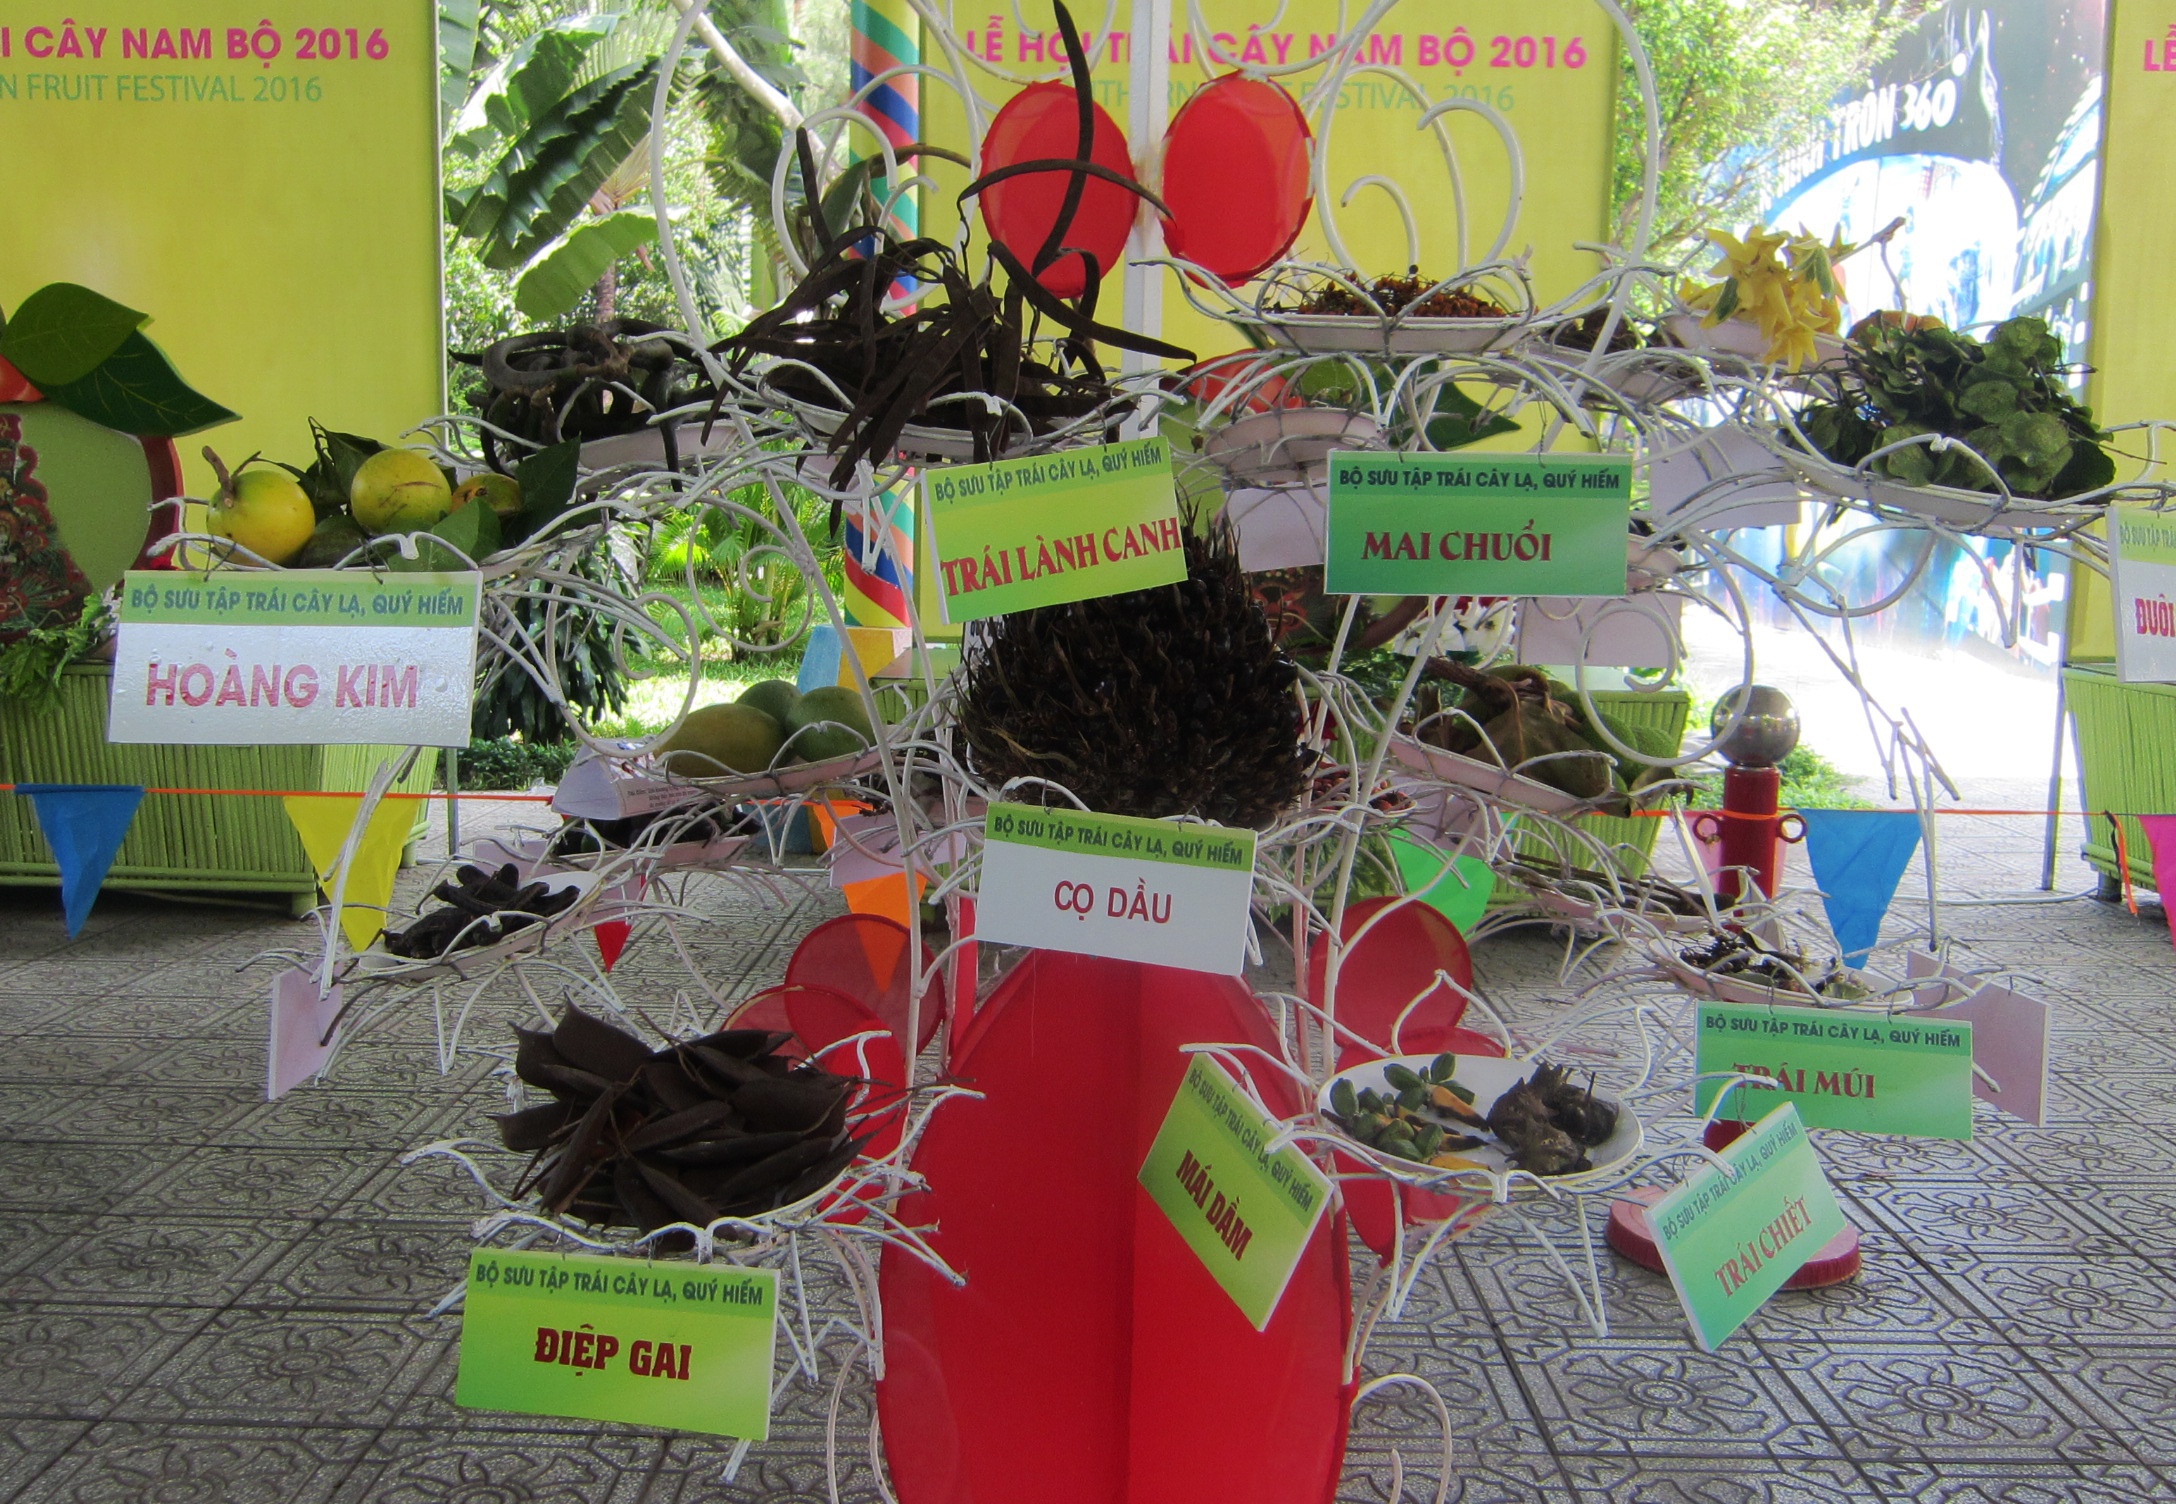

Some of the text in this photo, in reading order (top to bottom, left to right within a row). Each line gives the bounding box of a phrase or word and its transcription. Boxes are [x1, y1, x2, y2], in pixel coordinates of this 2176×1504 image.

[24, 18, 108, 59] CÂY
[121, 27, 213, 60] NAM
[226, 18, 283, 69] BỘ
[294, 28, 390, 61] 2016
[966, 15, 1003, 62] LỄ
[1208, 24, 1294, 65] CÂY
[1418, 26, 1476, 77] BỘ
[1489, 35, 1588, 69] 2016
[28, 73, 108, 101] FRUIT
[116, 74, 245, 102] FESTIVAL
[253, 75, 323, 103] 2016
[934, 441, 1162, 504] BỘ SƯU TẬP TRÁI CÂY LẠ, QUÝ HIẾM
[1339, 466, 1619, 493] BỘ SƯU TẬP TRÁI CÂY LẠ, QUÝ HIẾM
[940, 517, 1182, 597] TRÁI LÀNH CANH
[1361, 531, 1432, 560] MAI
[131, 583, 464, 619] BỘ SƯU TẬP TRÁI CÂY LẠ, QUÝ HIẾM
[146, 647, 419, 708] HOÀNG KIM
[994, 814, 1243, 865] BỘ SƯU TẬP TRÁI CÂY LẠ, QUÝ HIẾM
[1054, 876, 1172, 924] CỌ DẦU
[1705, 1014, 1961, 1048] BỘ SƯU TẬP TRÁI CÂY LẠ, QUÝ HIẾM
[1732, 1061, 1876, 1100] TRÁI MÚI
[1188, 1068, 1203, 1093] BỘ
[1198, 1080, 1217, 1105] SƯU
[1211, 1093, 1229, 1120] TẬP
[1225, 1108, 1244, 1138] TRÁI
[1241, 1124, 1262, 1153] CÂY
[1271, 1160, 1295, 1190] QUÝ
[1289, 1181, 1314, 1213] HIẾM
[1175, 1148, 1214, 1211] MÁI
[1661, 1215, 1680, 1242] BỘ
[1676, 1206, 1696, 1230] SƯU
[1693, 1191, 1711, 1218] TẬP
[1707, 1174, 1731, 1206] TRÁI
[1748, 1156, 1763, 1176] LẠ,
[1760, 1136, 1778, 1161] QUÝ
[1777, 1120, 1799, 1148] HIẾM
[475, 1260, 763, 1306] BỘ SƯU TẬP TRÁI CÂY LẠ, QUÝ HIẾM
[1714, 1241, 1764, 1299] TRÁI
[534, 1322, 692, 1381] ĐIỆP GAI
